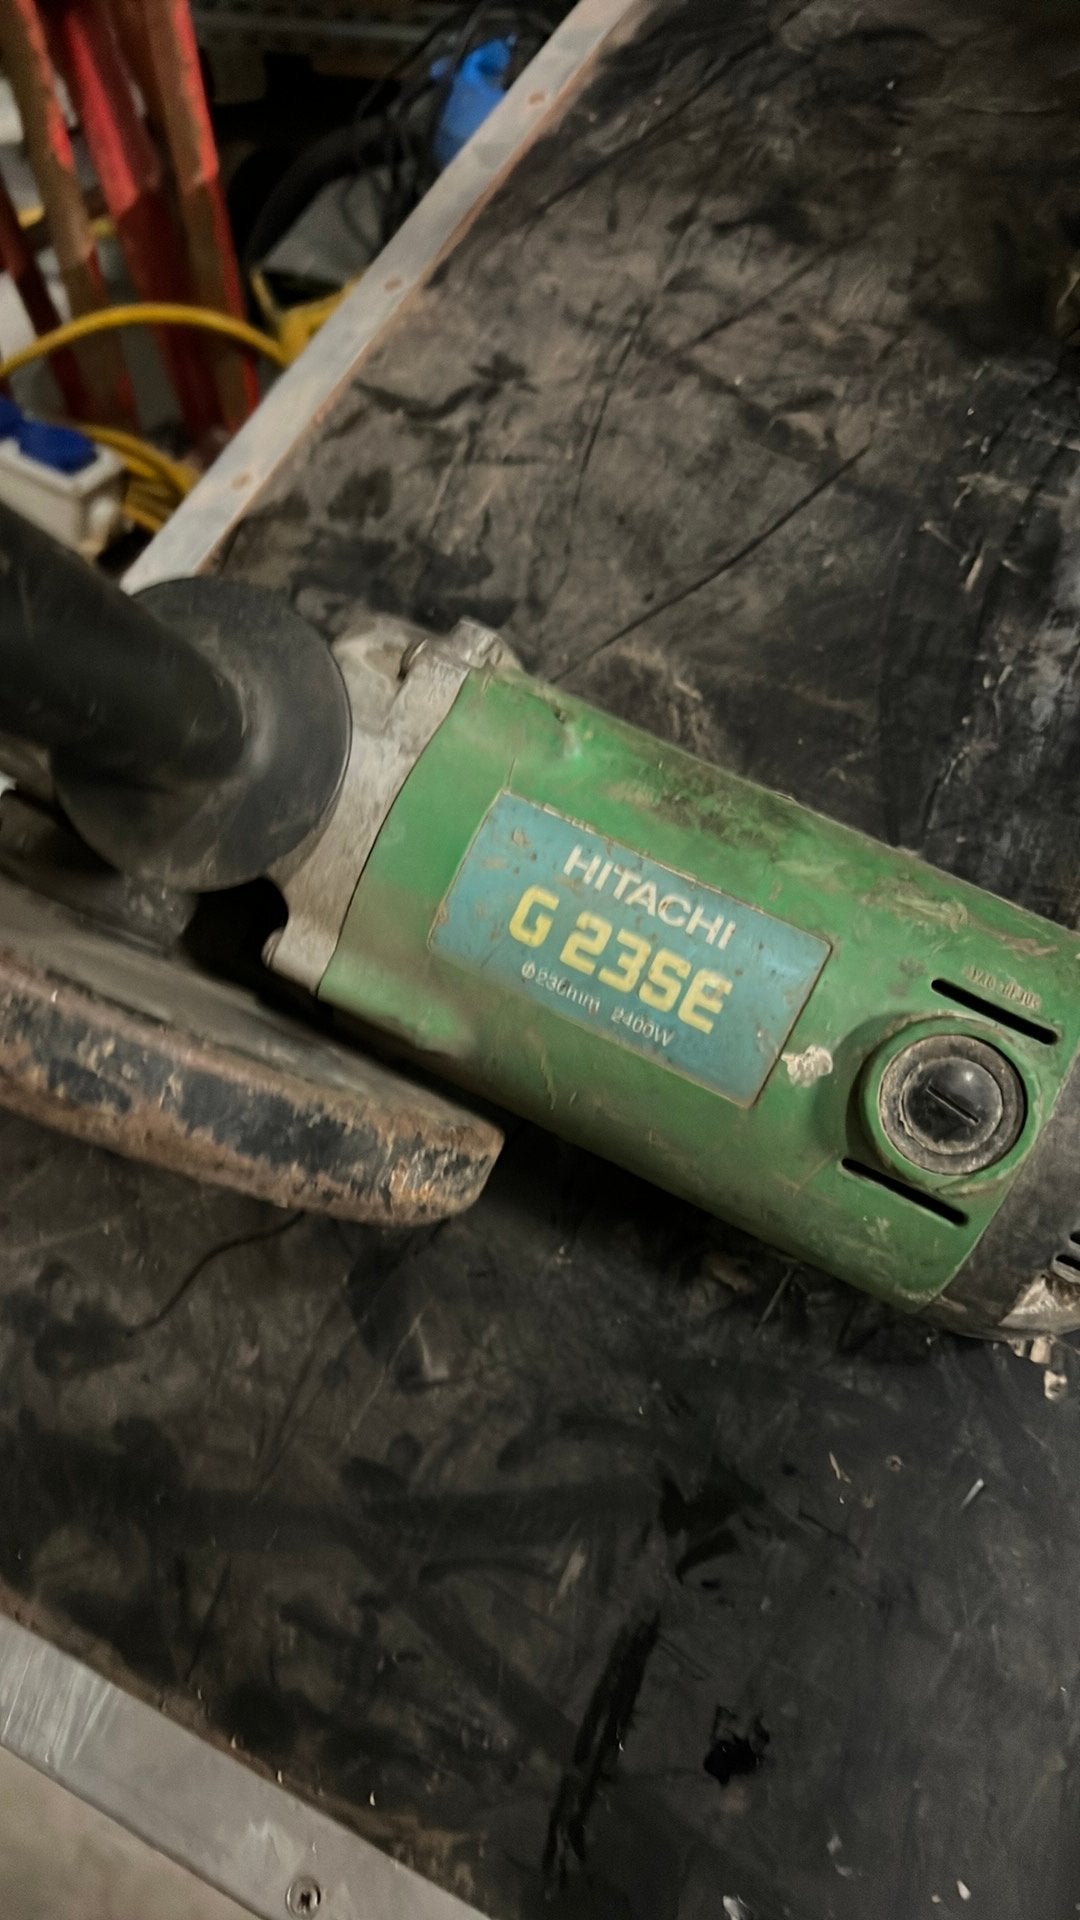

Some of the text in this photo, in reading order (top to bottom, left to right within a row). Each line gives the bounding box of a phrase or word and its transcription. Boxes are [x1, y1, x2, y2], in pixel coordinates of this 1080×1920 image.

[508, 884, 733, 1034] G 23SE
[563, 844, 736, 950] HITACHI
